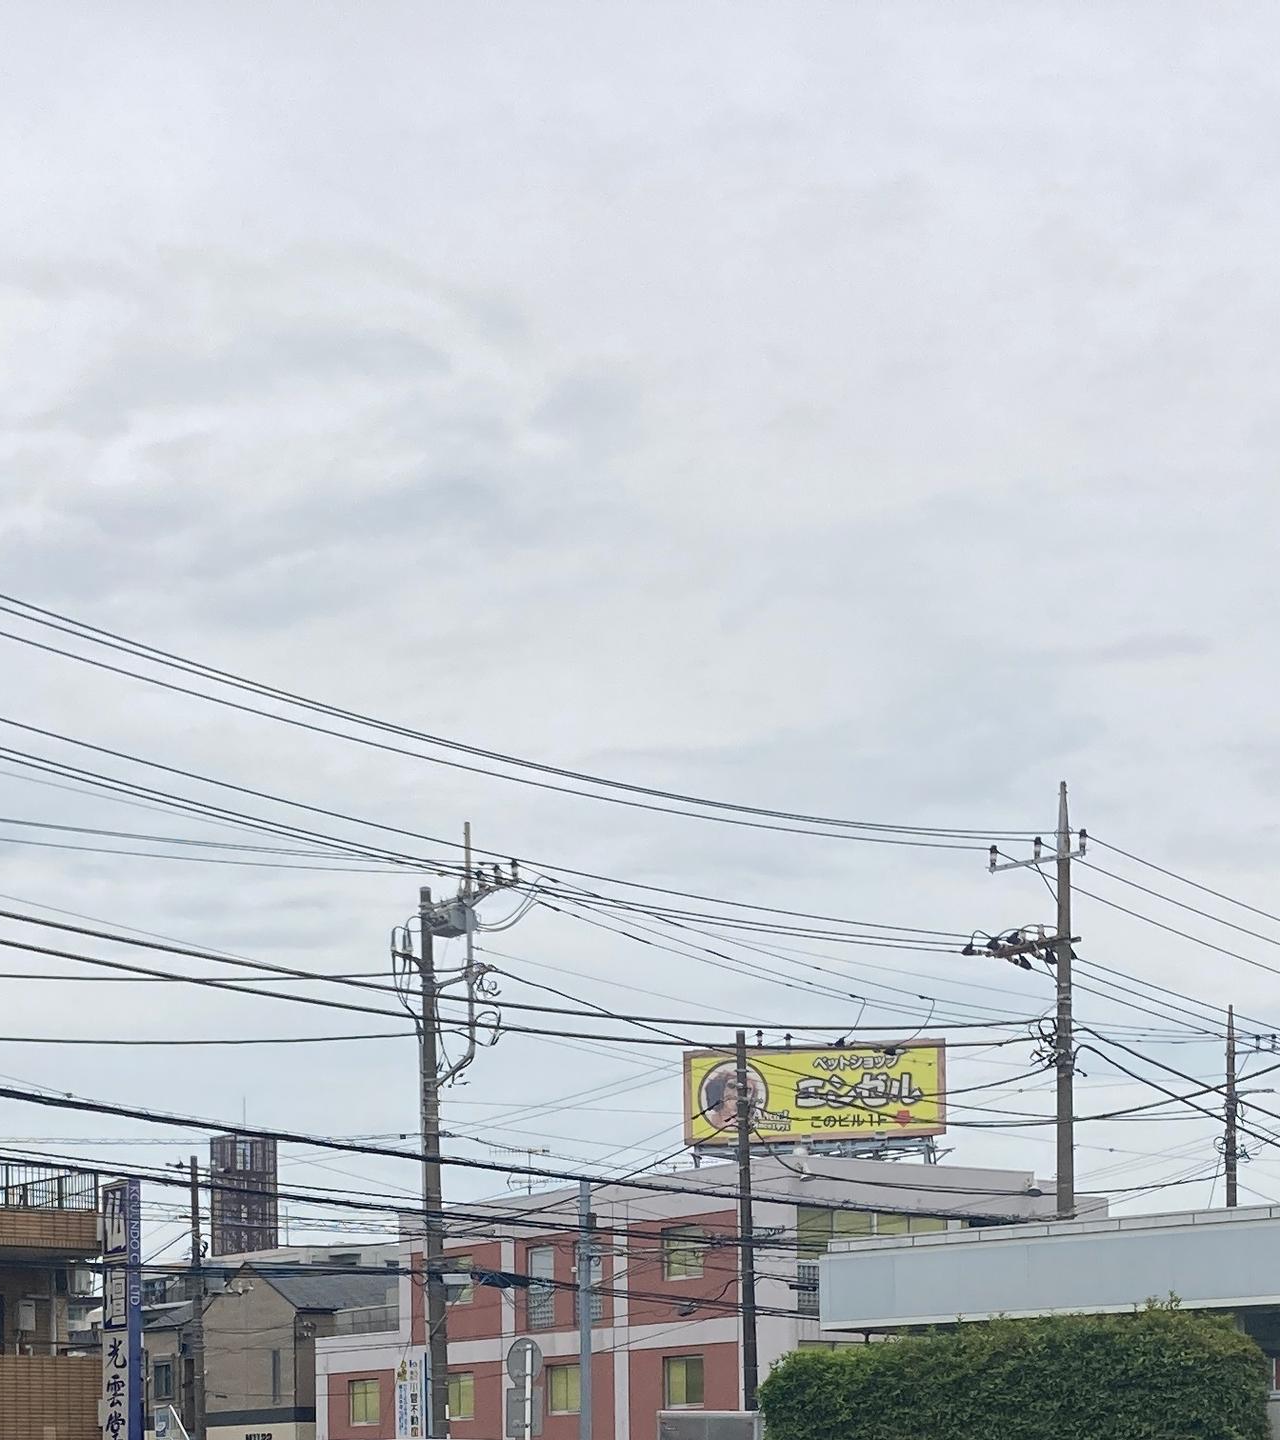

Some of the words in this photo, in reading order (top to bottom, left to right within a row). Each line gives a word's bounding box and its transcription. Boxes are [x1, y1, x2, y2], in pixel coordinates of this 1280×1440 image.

[812, 1053, 900, 1071] ペットショップ
